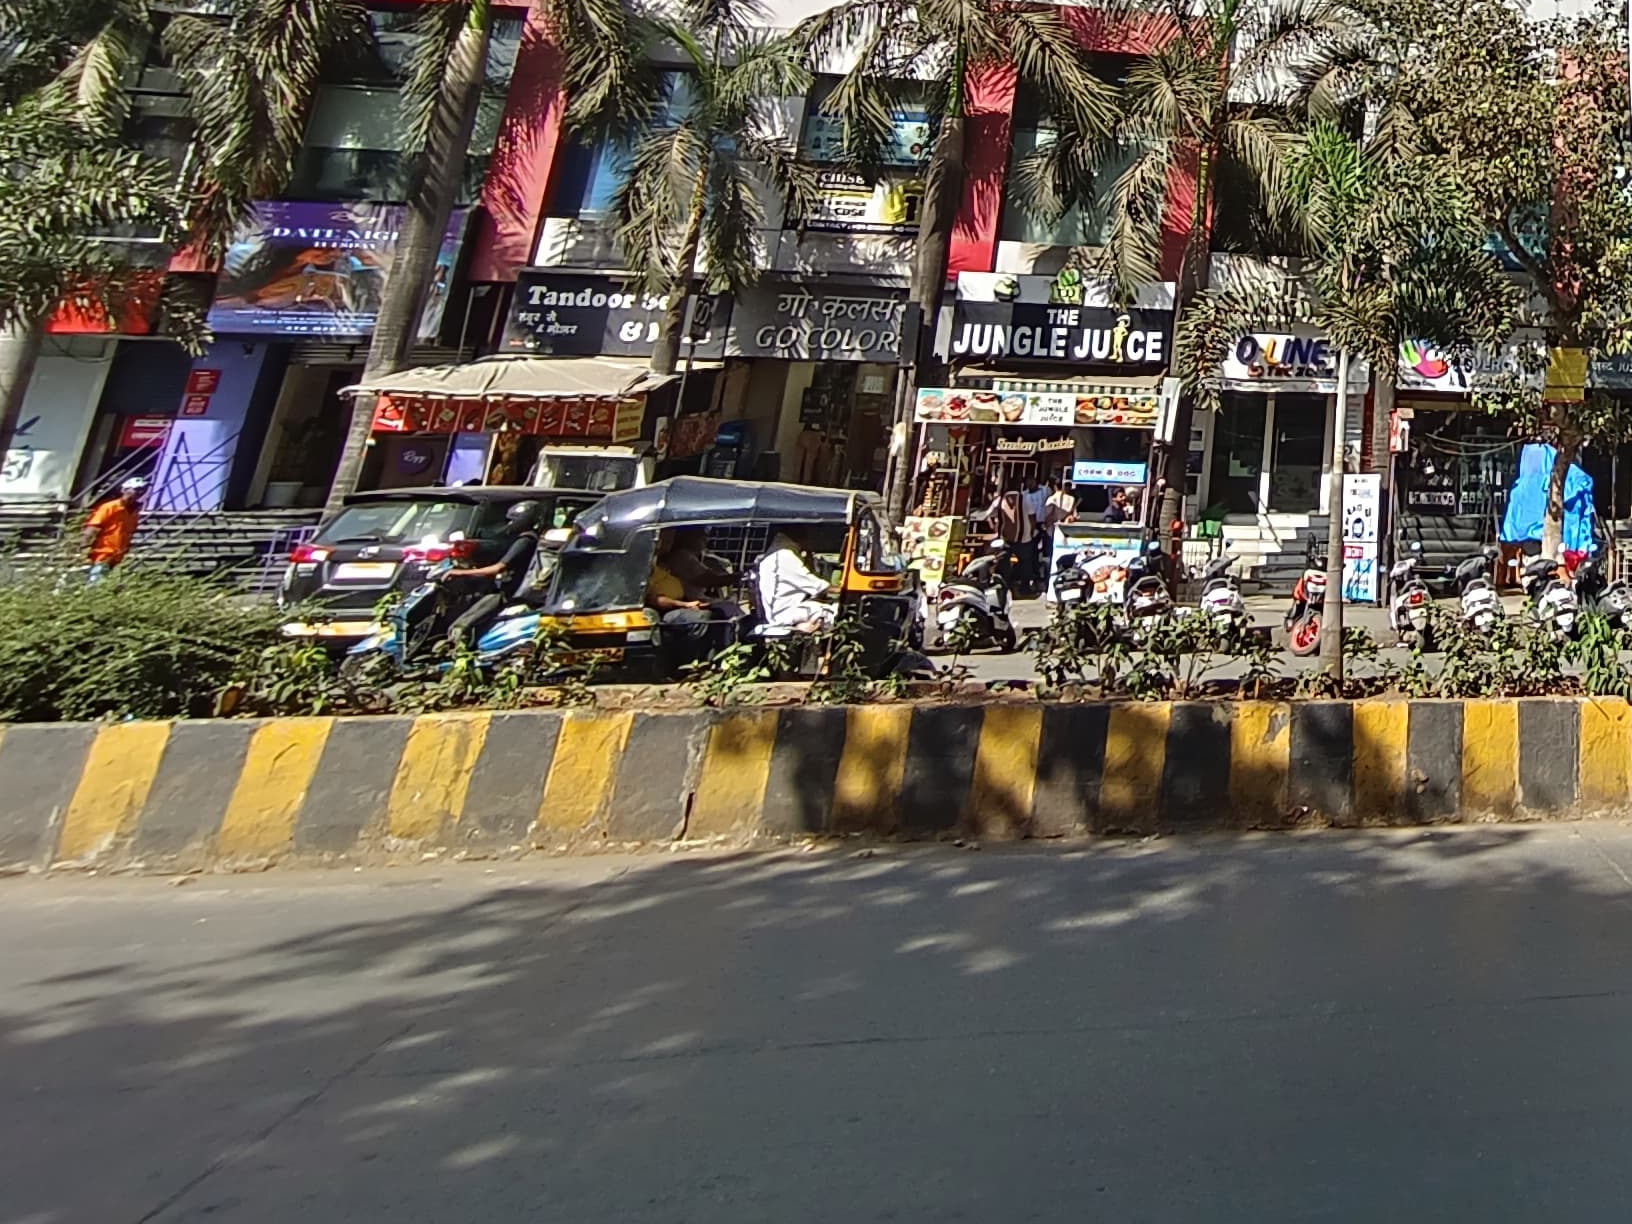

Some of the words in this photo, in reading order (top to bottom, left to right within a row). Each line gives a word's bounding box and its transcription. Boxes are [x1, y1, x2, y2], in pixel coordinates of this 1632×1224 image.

[528, 285, 637, 310] Tandoor
[777, 287, 814, 318] गो
[822, 291, 900, 321] कलर्स
[1047, 309, 1080, 326] THE
[756, 324, 799, 350] GO
[807, 326, 899, 353] COLOR
[953, 323, 1068, 358] JUNGLE
[1074, 315, 1164, 363] JUICE
